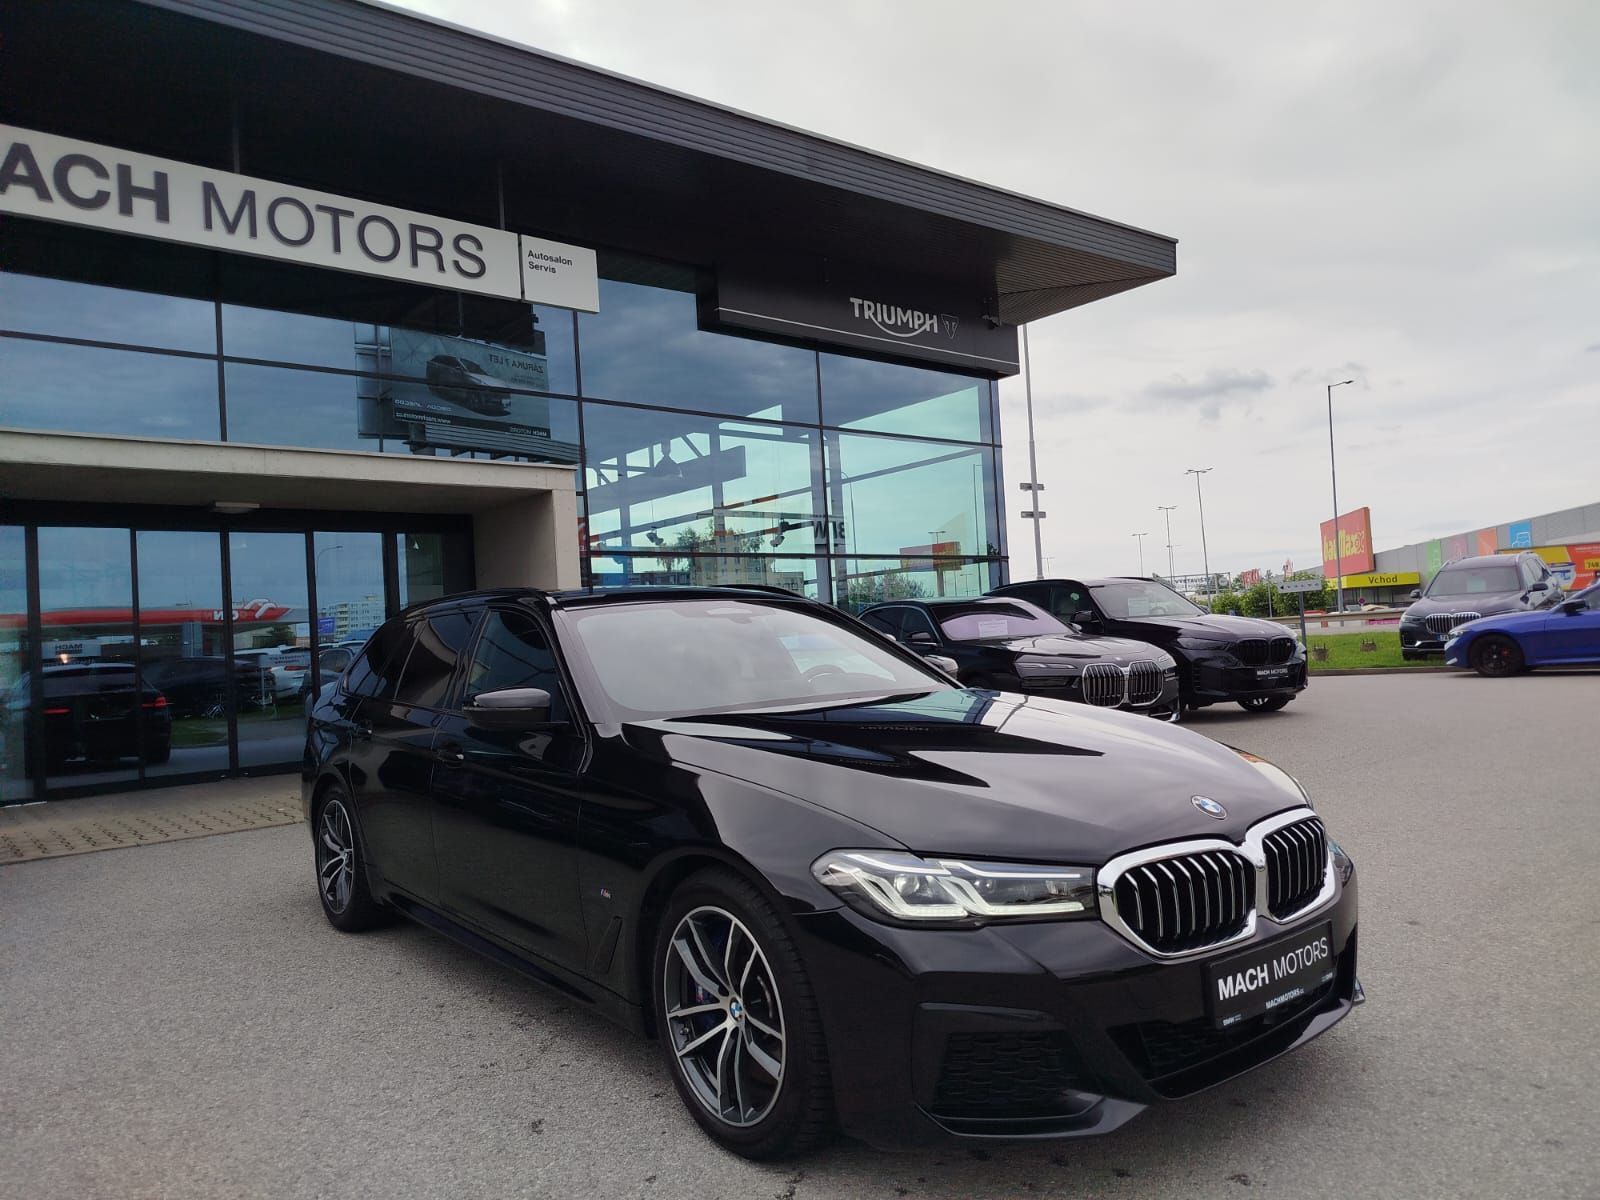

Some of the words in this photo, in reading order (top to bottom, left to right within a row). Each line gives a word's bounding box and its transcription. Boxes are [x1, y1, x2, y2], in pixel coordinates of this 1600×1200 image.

[203, 181, 487, 280] MOTORS
[528, 249, 573, 266] Autosalon
[528, 261, 557, 273] Servis
[849, 297, 938, 336] TRIUMPH
[1368, 575, 1398, 585] Vchod
[1217, 964, 1269, 1001] MACH
[1273, 937, 1328, 981] MOTORS
